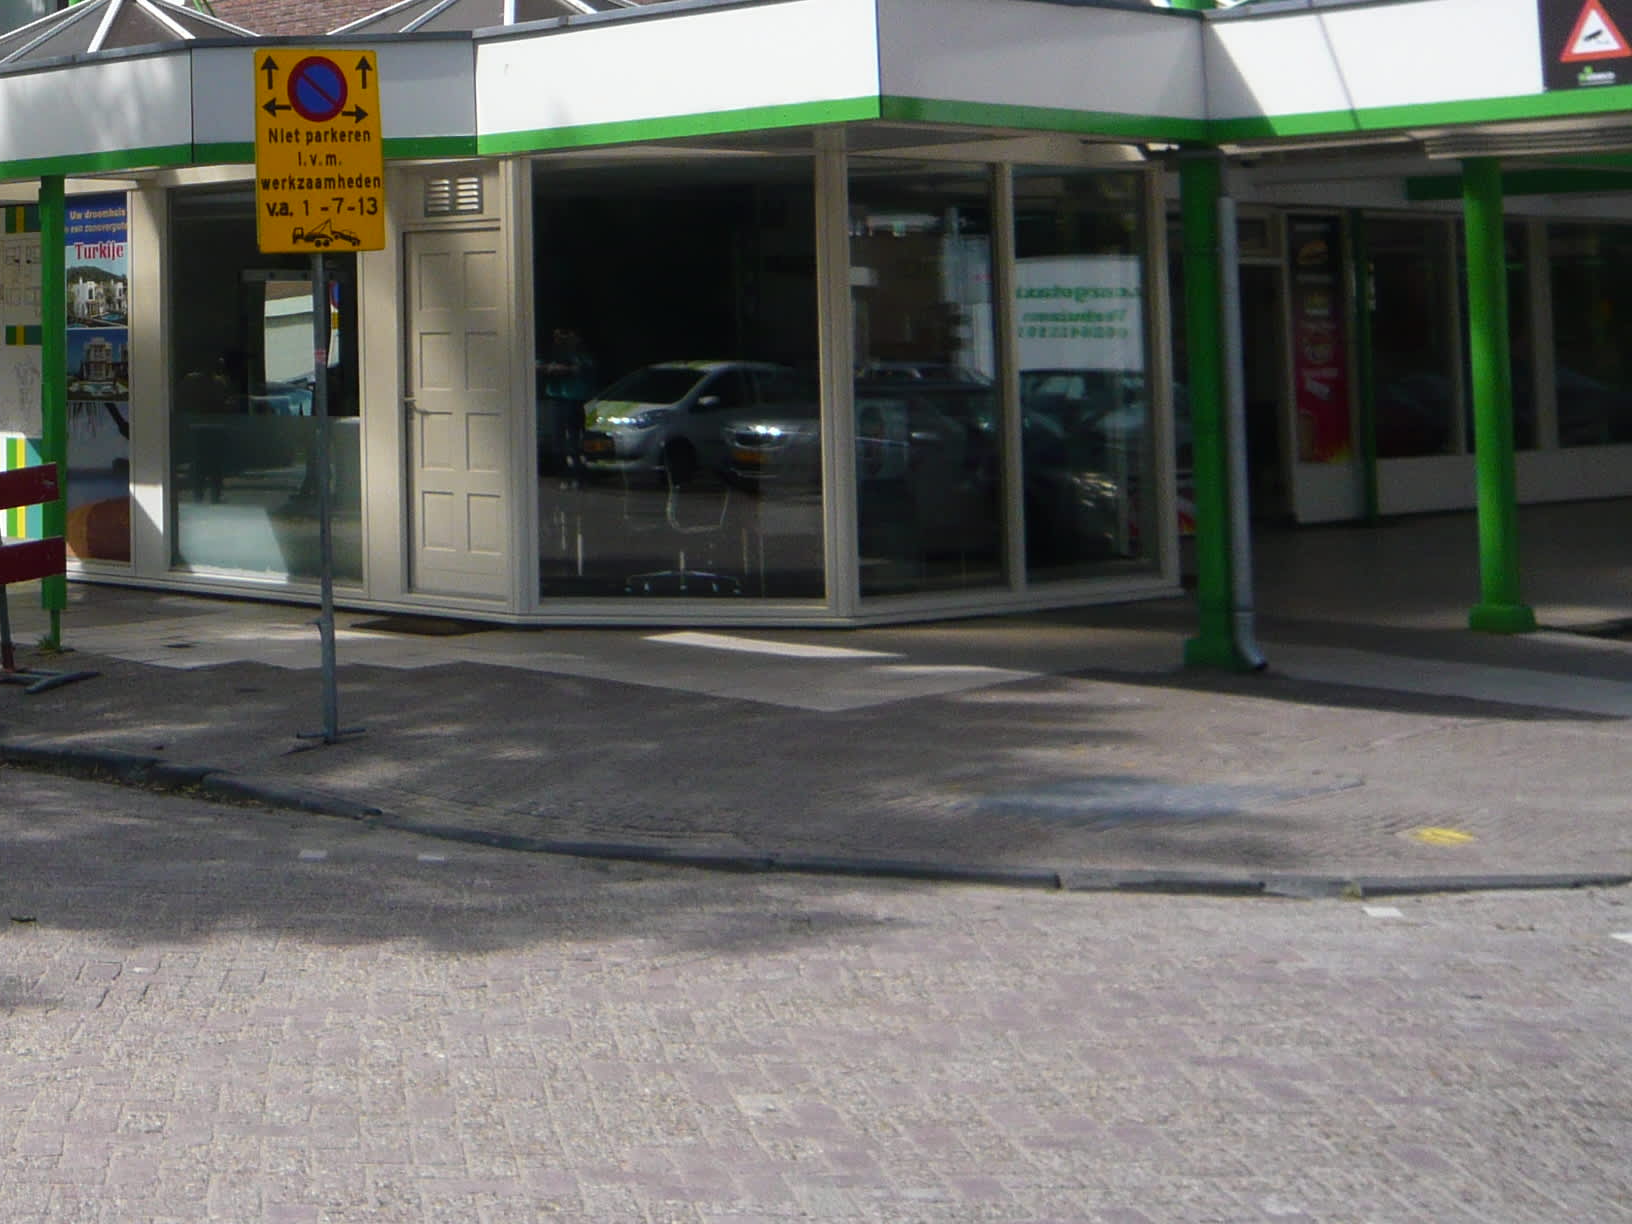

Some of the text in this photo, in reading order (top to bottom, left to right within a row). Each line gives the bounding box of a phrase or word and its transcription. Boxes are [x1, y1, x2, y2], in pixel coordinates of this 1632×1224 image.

[268, 127, 371, 147] Niet parkeren
[261, 172, 381, 190] werkzaamheden
[266, 201, 293, 217] v.a.
[74, 240, 124, 261] Turkije
